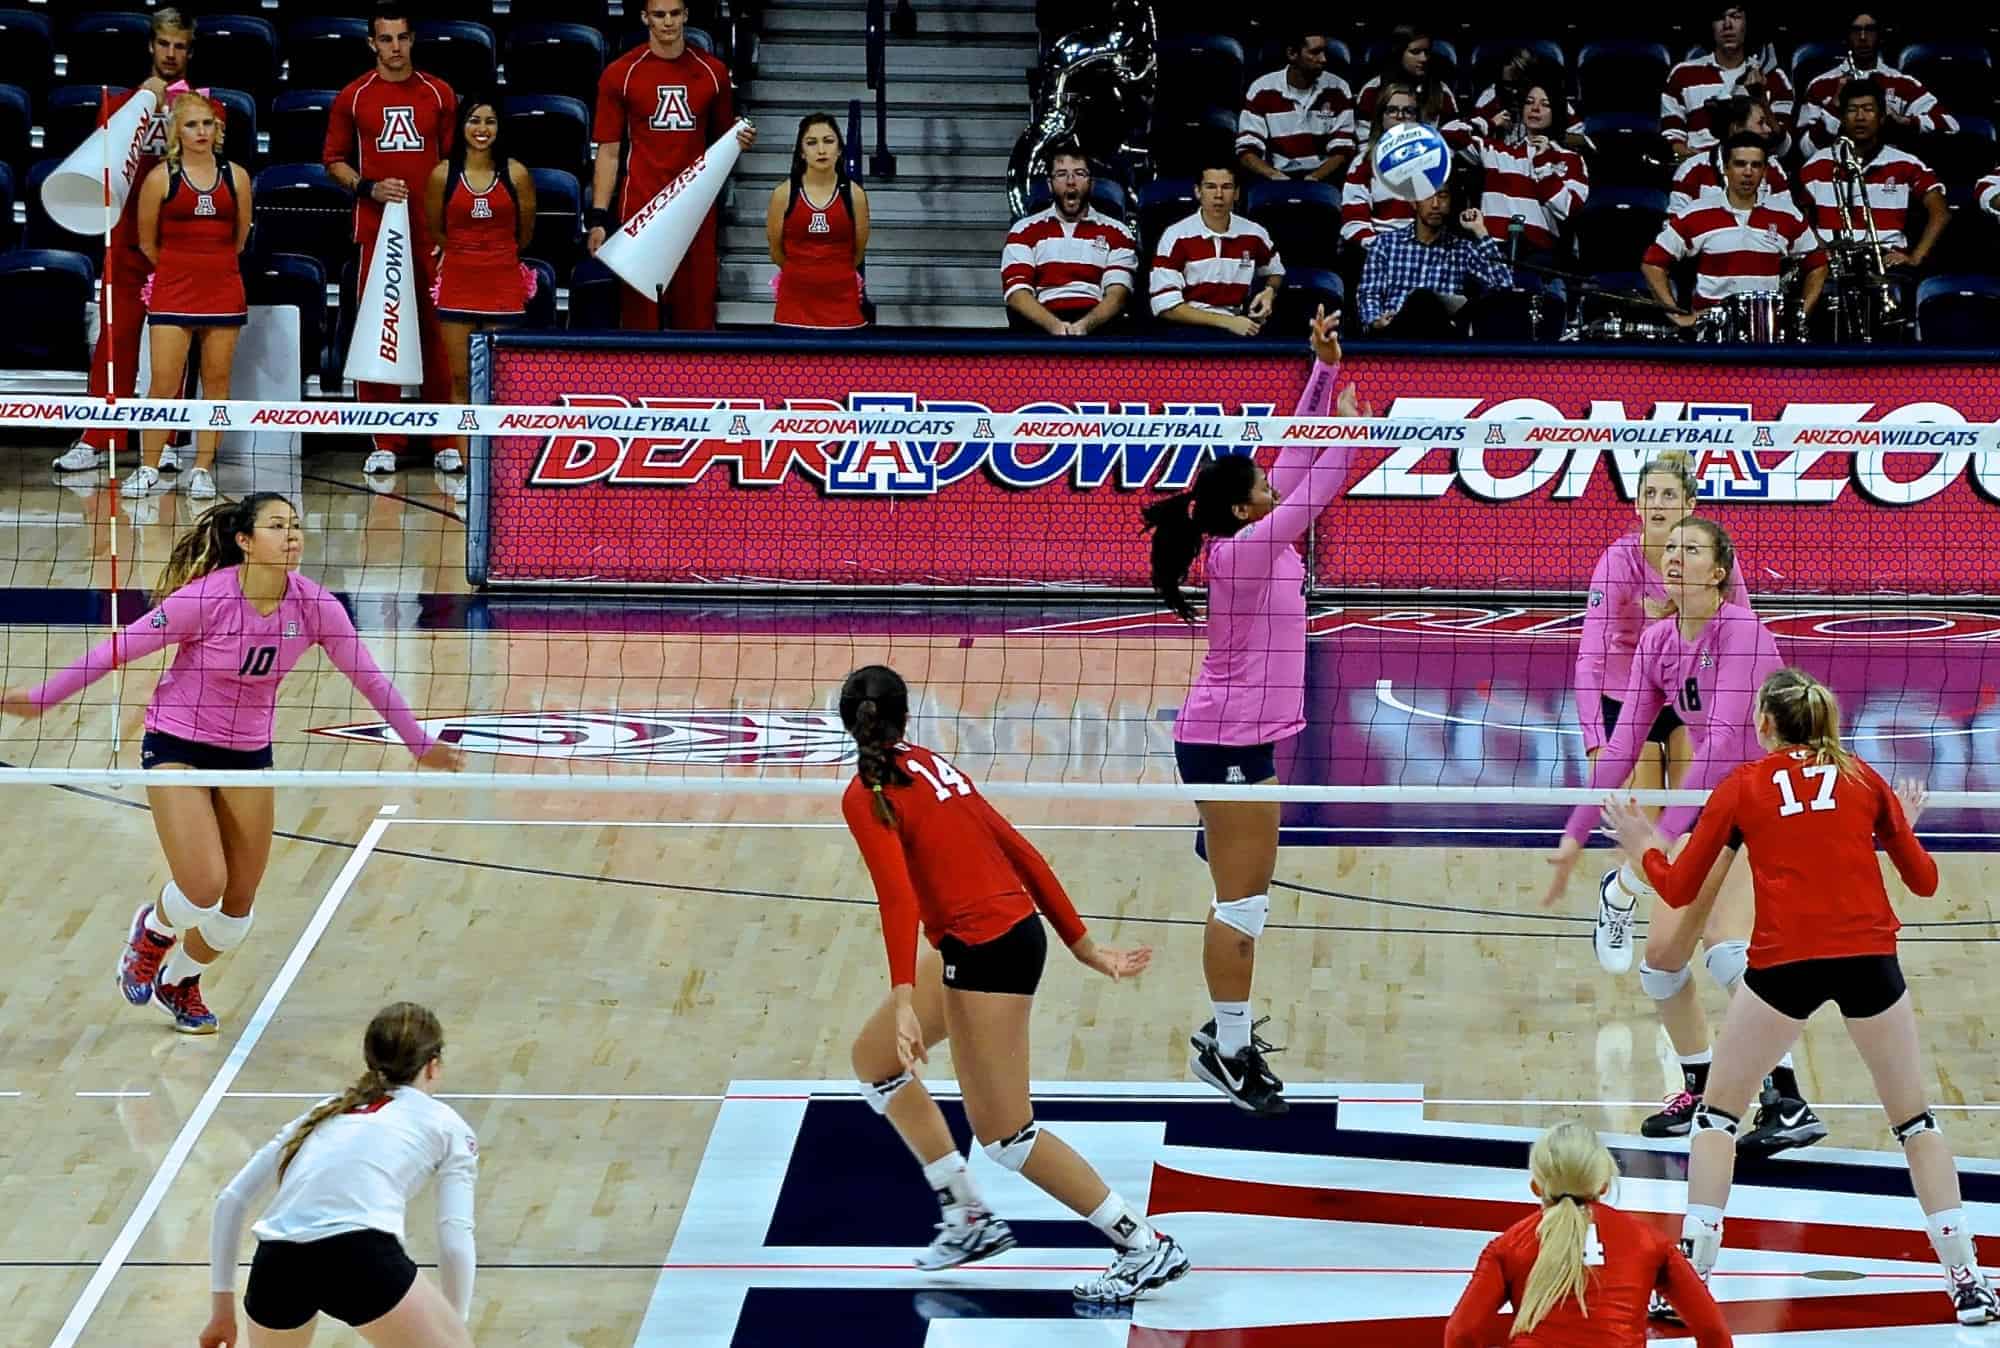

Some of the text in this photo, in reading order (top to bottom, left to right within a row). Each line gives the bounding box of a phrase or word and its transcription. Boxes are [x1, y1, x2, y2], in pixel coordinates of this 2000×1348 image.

[648, 85, 697, 131] A
[375, 106, 425, 152] A
[195, 195, 216, 216] A
[471, 198, 492, 218] A
[808, 213, 830, 233] A
[209, 406, 232, 427] A
[457, 409, 480, 430] A
[728, 415, 752, 435] A
[973, 418, 996, 438] A
[1241, 421, 1264, 441] A
[1484, 424, 1507, 444] A
[1752, 426, 1775, 447] A
[238, 645, 278, 677] 10
[1679, 676, 1702, 712] 18
[906, 755, 972, 802] 14
[1772, 764, 1838, 816] 17
